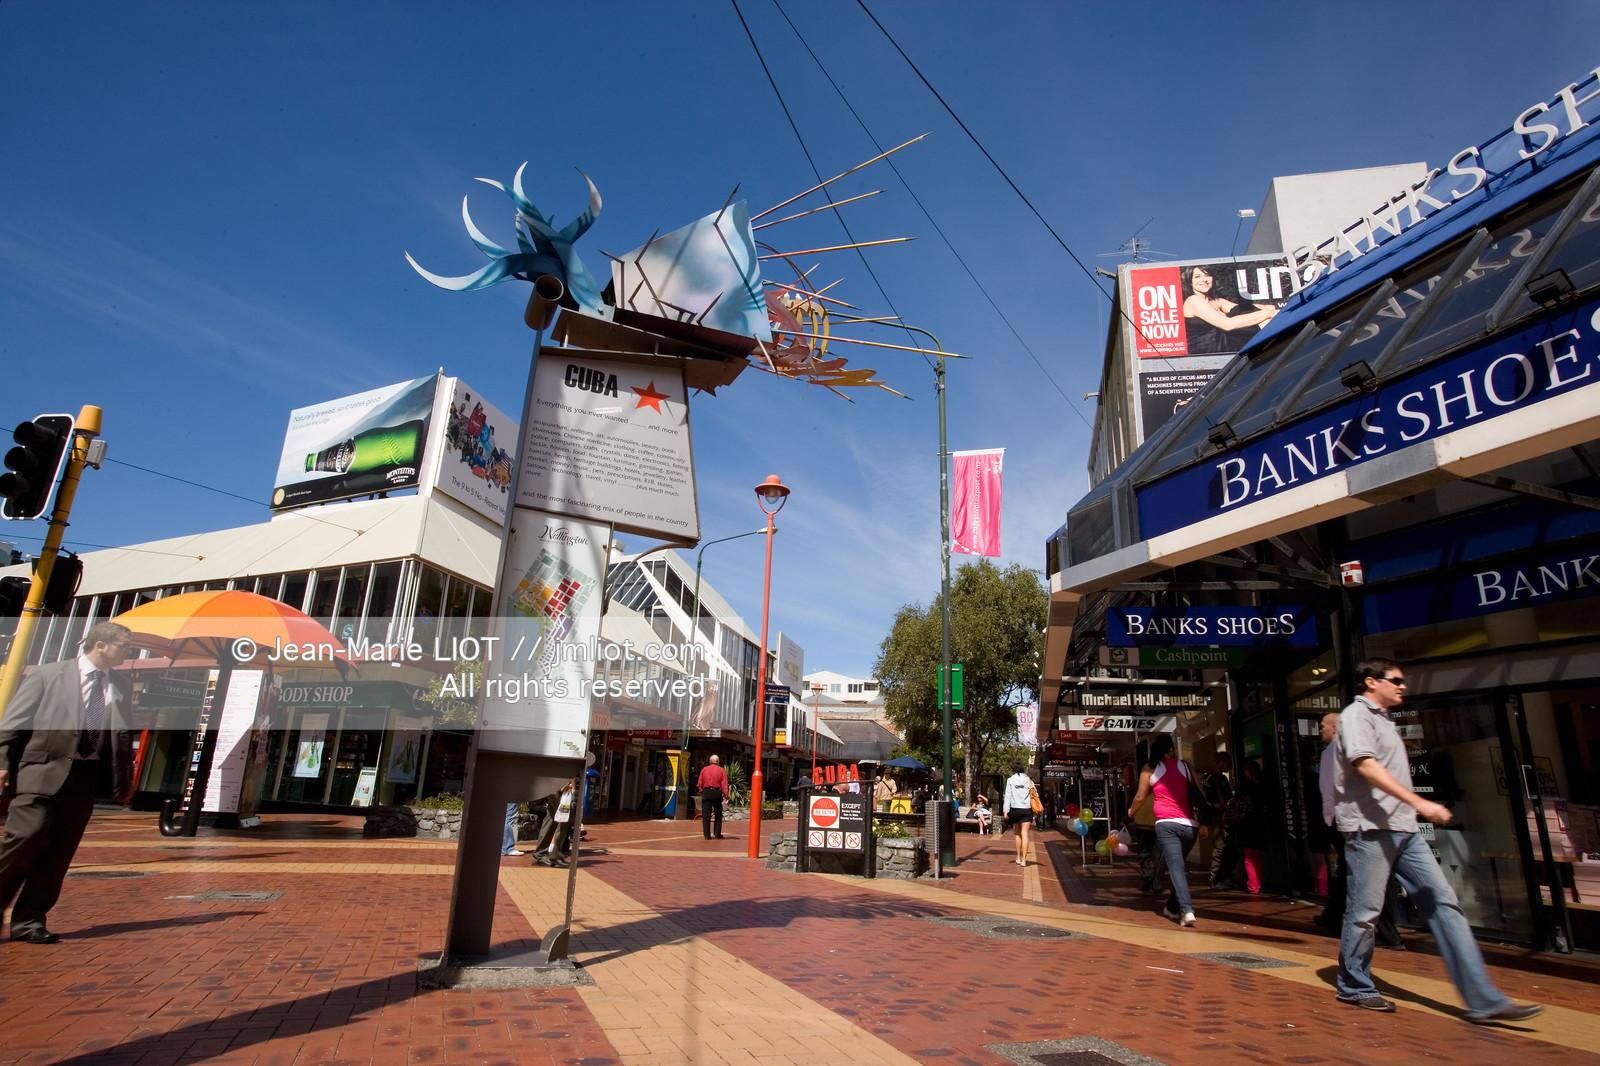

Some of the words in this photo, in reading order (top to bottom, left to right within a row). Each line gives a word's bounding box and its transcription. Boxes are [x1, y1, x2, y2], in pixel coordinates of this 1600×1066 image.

[1282, 145, 1488, 294] BANKS
[1138, 285, 1178, 310] ON
[1140, 309, 1179, 325] SALE
[1141, 324, 1179, 340] NOW
[564, 364, 618, 398] CUBA
[537, 398, 572, 412] Everything
[573, 405, 587, 415] you
[604, 414, 628, 424] wanted
[661, 427, 678, 436] more
[533, 419, 569, 431] acupuncture,
[606, 436, 640, 446] automobiles,
[551, 438, 582, 448] computers,
[672, 463, 689, 472] fishing
[564, 432, 585, 441] Chinese
[657, 454, 686, 463] commity
[1216, 407, 1386, 508] BANKS
[574, 457, 596, 466] heritage
[452, 475, 460, 487] The
[537, 492, 548, 500] the
[550, 495, 566, 503] most
[568, 497, 601, 511] fascinating
[624, 509, 646, 519] people
[655, 514, 665, 522] the
[666, 517, 688, 527] country
[1474, 556, 1600, 606] BANK
[1126, 614, 1207, 635] BANKS
[1217, 614, 1295, 635] SHOES
[1156, 650, 1227, 664] Cashpoint
[313, 687, 353, 702] SHOP
[1082, 693, 1131, 706] Michael
[1133, 693, 1154, 706] Hill
[1155, 693, 1210, 706] Jeweller
[1082, 717, 1104, 729] EB
[1104, 718, 1156, 729] GAMES
[814, 764, 859, 784] CUBA
